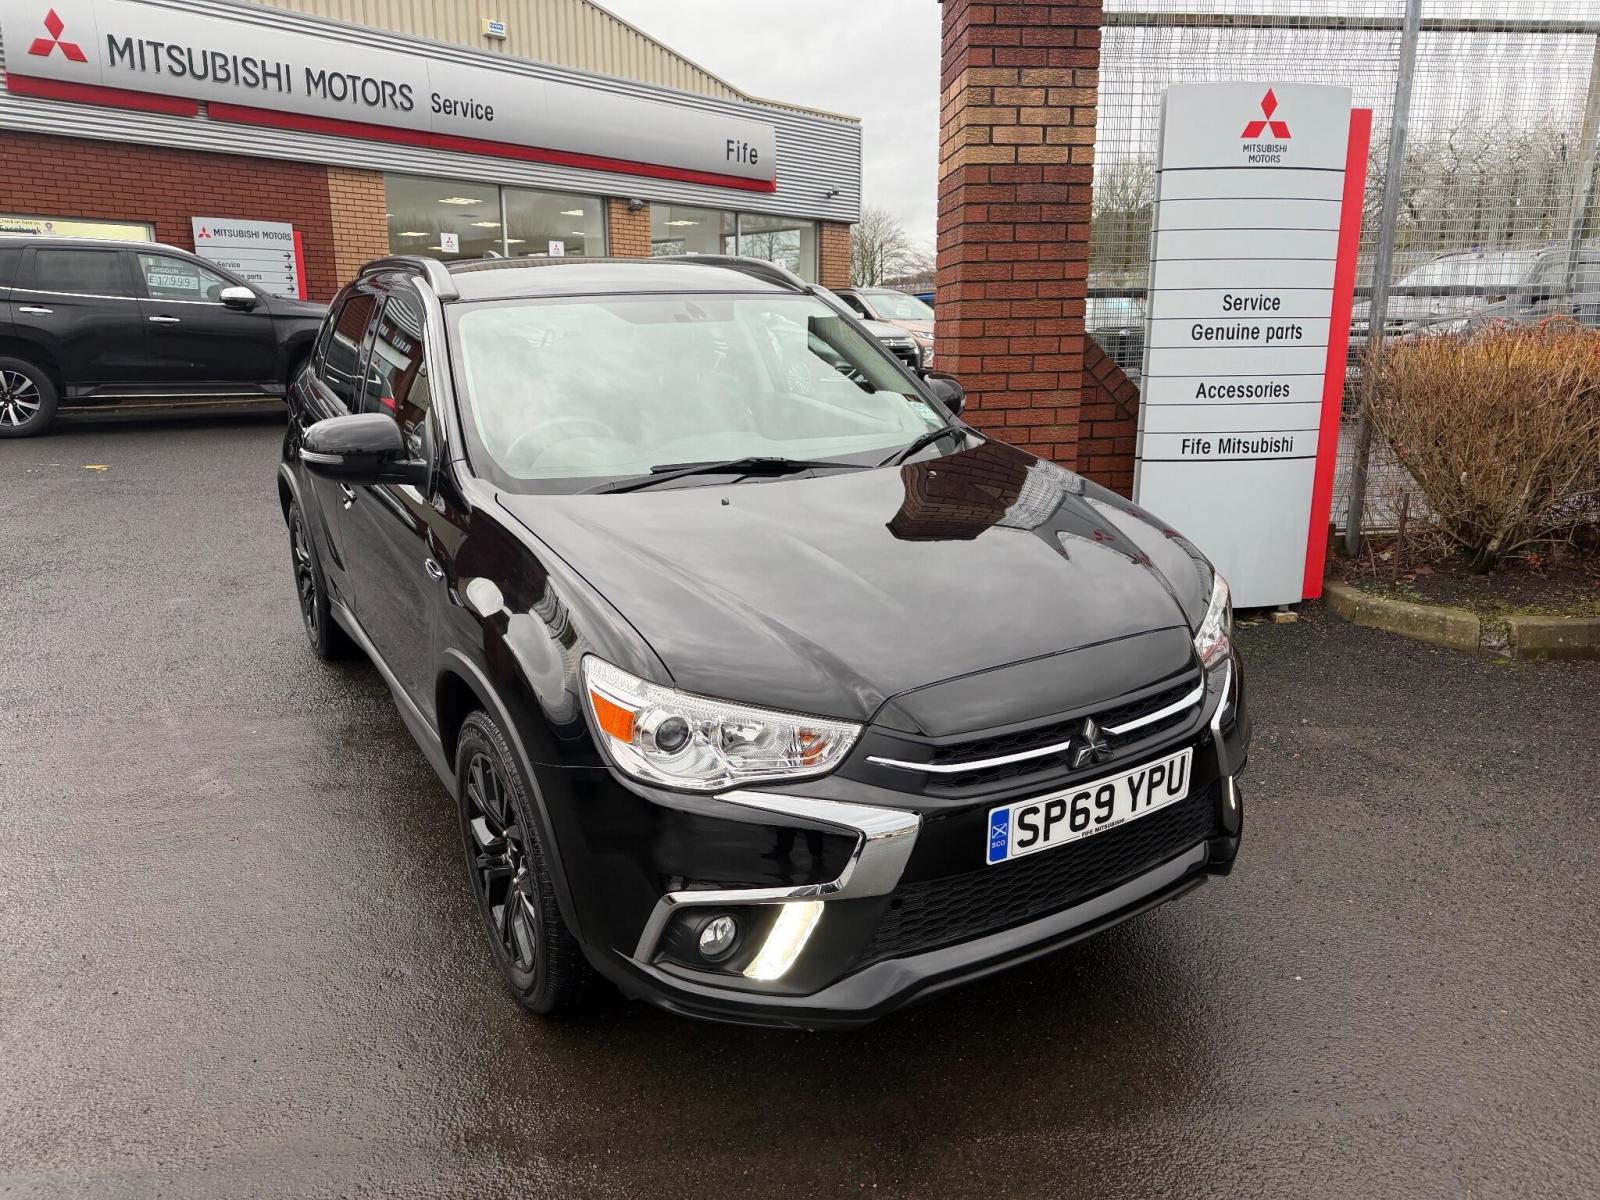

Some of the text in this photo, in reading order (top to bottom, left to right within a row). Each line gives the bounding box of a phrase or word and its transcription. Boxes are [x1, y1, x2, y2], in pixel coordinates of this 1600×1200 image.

[106, 34, 414, 112] MITSUBISHI MOTORS
[431, 92, 495, 122] Service
[726, 139, 759, 166] Fife
[1242, 143, 1289, 153] MITSUBISHI
[1248, 154, 1281, 163] MOTORS
[213, 228, 292, 241] MITSUBISHI MOTORS
[1222, 293, 1281, 312] Service
[1191, 323, 1303, 344] Genuine parts
[1195, 382, 1290, 399] Accessories
[1181, 436, 1294, 455] Fife Mitsubishi
[1016, 755, 1186, 848] SP69 YPU
[991, 839, 1006, 849] SCO
